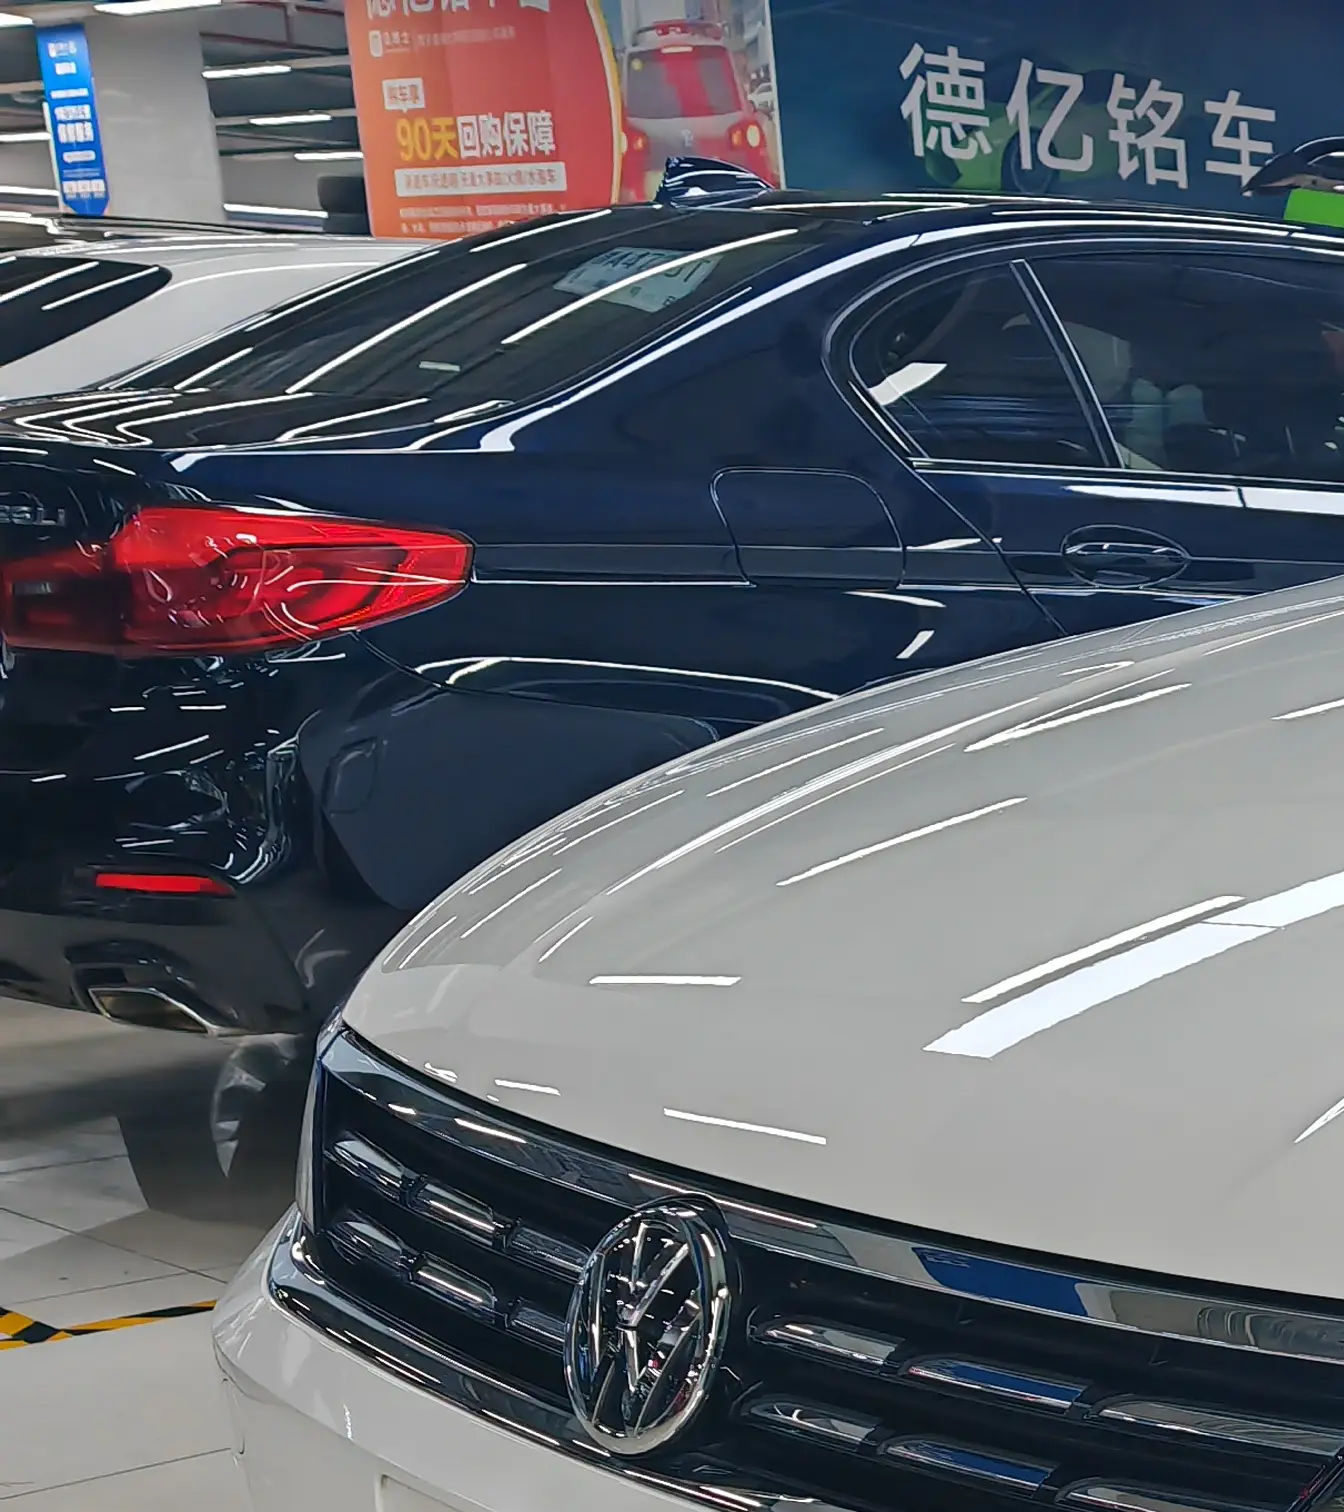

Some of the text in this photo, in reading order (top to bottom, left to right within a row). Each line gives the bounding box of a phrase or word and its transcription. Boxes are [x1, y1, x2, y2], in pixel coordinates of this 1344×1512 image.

[396, 110, 556, 162] 90天回购保障
[899, 42, 1277, 197] 德亿铭车
